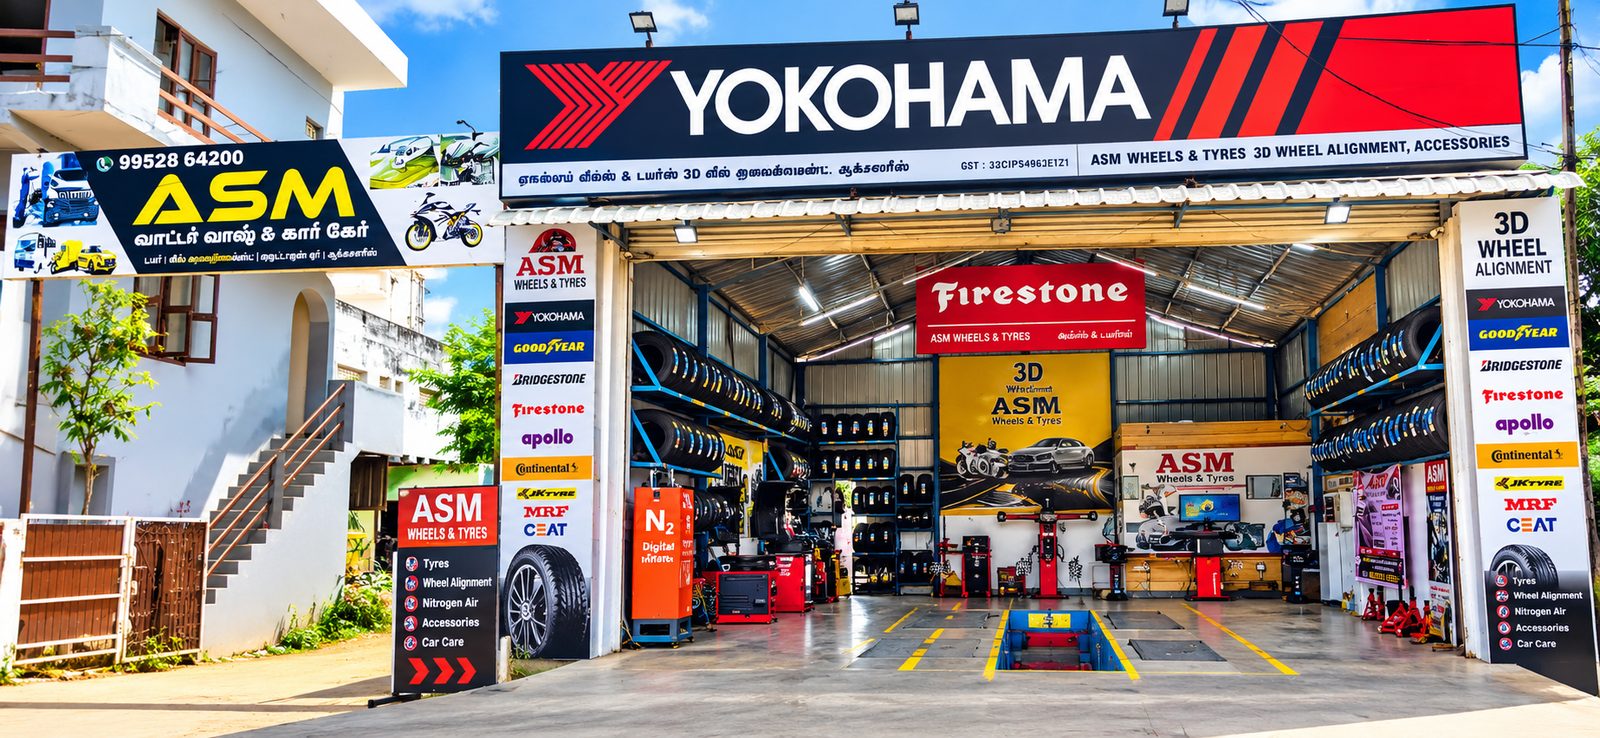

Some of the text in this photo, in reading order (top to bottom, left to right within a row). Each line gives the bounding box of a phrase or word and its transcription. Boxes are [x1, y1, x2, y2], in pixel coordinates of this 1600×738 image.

[669, 54, 1152, 137] YOKOHAMA
[1090, 135, 1511, 166] ASM WHEELS & TYRES 3D WHEEL ALIGNMENT, ACCESSORIES
[119, 149, 244, 171] 99528 64200
[961, 161, 979, 171] GST
[621, 170, 632, 182] &
[683, 168, 701, 180] 3D
[131, 166, 356, 227] ASM
[260, 226, 276, 241] &
[281, 221, 321, 240] கார்
[326, 219, 370, 239] கேர்
[1494, 211, 1529, 235] 3D
[1477, 238, 1547, 259] WHEEL
[516, 254, 585, 277] ASM
[1475, 260, 1553, 277] ALIGNMENT
[514, 277, 587, 291] WHEELS & TYRES
[931, 280, 1128, 313] Firestone
[1496, 297, 1556, 309] YOKOHAMA
[532, 311, 585, 323] YOKOHAMA
[930, 331, 1031, 344] ASM WHEELS & TYRES
[1479, 324, 1558, 341] GOODYEAR
[513, 338, 585, 355] GOODYEAR
[1013, 362, 1044, 382] 3D
[1480, 359, 1563, 372] BRIDGESTONE
[512, 373, 587, 386] BRIDGESTONE
[1482, 389, 1564, 405] Firestone
[512, 403, 585, 419] Firestone
[992, 416, 1062, 427] Wheels & Tyres
[1495, 413, 1554, 436] apollo
[521, 428, 574, 450] apollo
[1156, 452, 1235, 474] ASM
[1491, 449, 1553, 464] Continental
[515, 462, 570, 476] Continental
[1427, 463, 1445, 484] ASM
[1196, 474, 1204, 483] &
[1207, 473, 1235, 484] Tyres
[411, 492, 483, 524] ASM
[1504, 497, 1557, 511] MRF
[523, 505, 569, 518] MRF
[523, 523, 568, 537] CEAT
[1506, 517, 1558, 533] CEAT
[407, 526, 488, 541] WHEELS & TYRES
[423, 558, 450, 569] Tyres
[422, 576, 493, 590] Wheel Alignment
[1512, 577, 1537, 586] Tyres
[1513, 591, 1583, 601] Wheel Alignment
[422, 597, 479, 610] Nitrogen Air
[1514, 607, 1567, 617] Nitrogen Air
[422, 617, 480, 628] Accessories
[1515, 623, 1570, 632] Accessories
[422, 637, 464, 648] Car Care
[1517, 640, 1557, 648] Car Care
